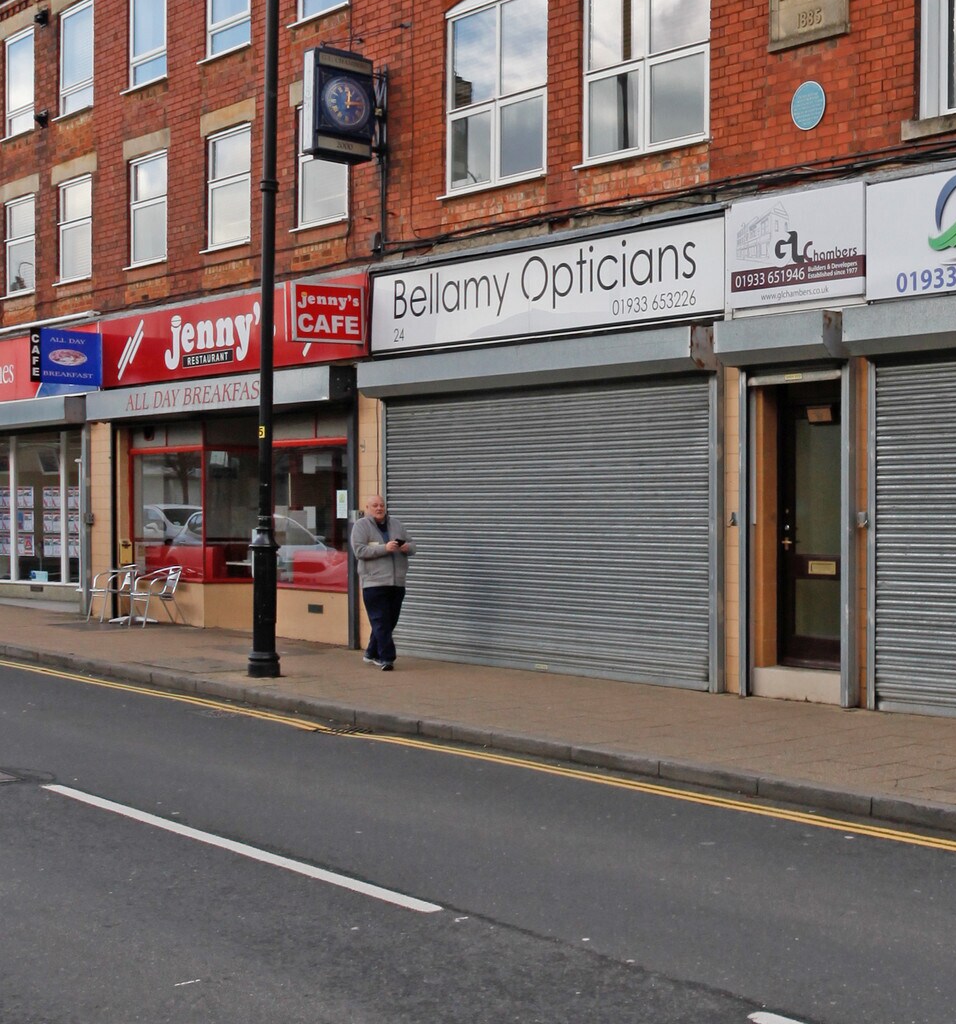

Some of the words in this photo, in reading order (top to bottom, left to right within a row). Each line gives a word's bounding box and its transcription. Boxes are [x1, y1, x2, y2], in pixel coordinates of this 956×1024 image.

[796, 8, 822, 29] 1885
[831, 261, 858, 269] Developers
[393, 272, 510, 320] Bellamy
[521, 240, 697, 309] Opticians
[735, 272, 765, 288] 01933
[767, 267, 805, 284] 651946
[896, 266, 956, 293] 01933
[297, 291, 359, 310] jenny's
[612, 297, 648, 316] 01933
[652, 290, 697, 311] 653226
[760, 285, 829, 301] www.glchambers.co.uk
[297, 313, 359, 335] CAFE
[49, 336, 66, 344] ALL
[164, 301, 276, 370] jenny'
[393, 328, 405, 343] 24
[31, 334, 40, 377] CAFE
[187, 351, 229, 366] RESTAURANT
[43, 370, 94, 379] BREAKFAST
[125, 393, 149, 412] ALL
[153, 389, 180, 409] DAY
[182, 380, 260, 406] BREAKFAS
